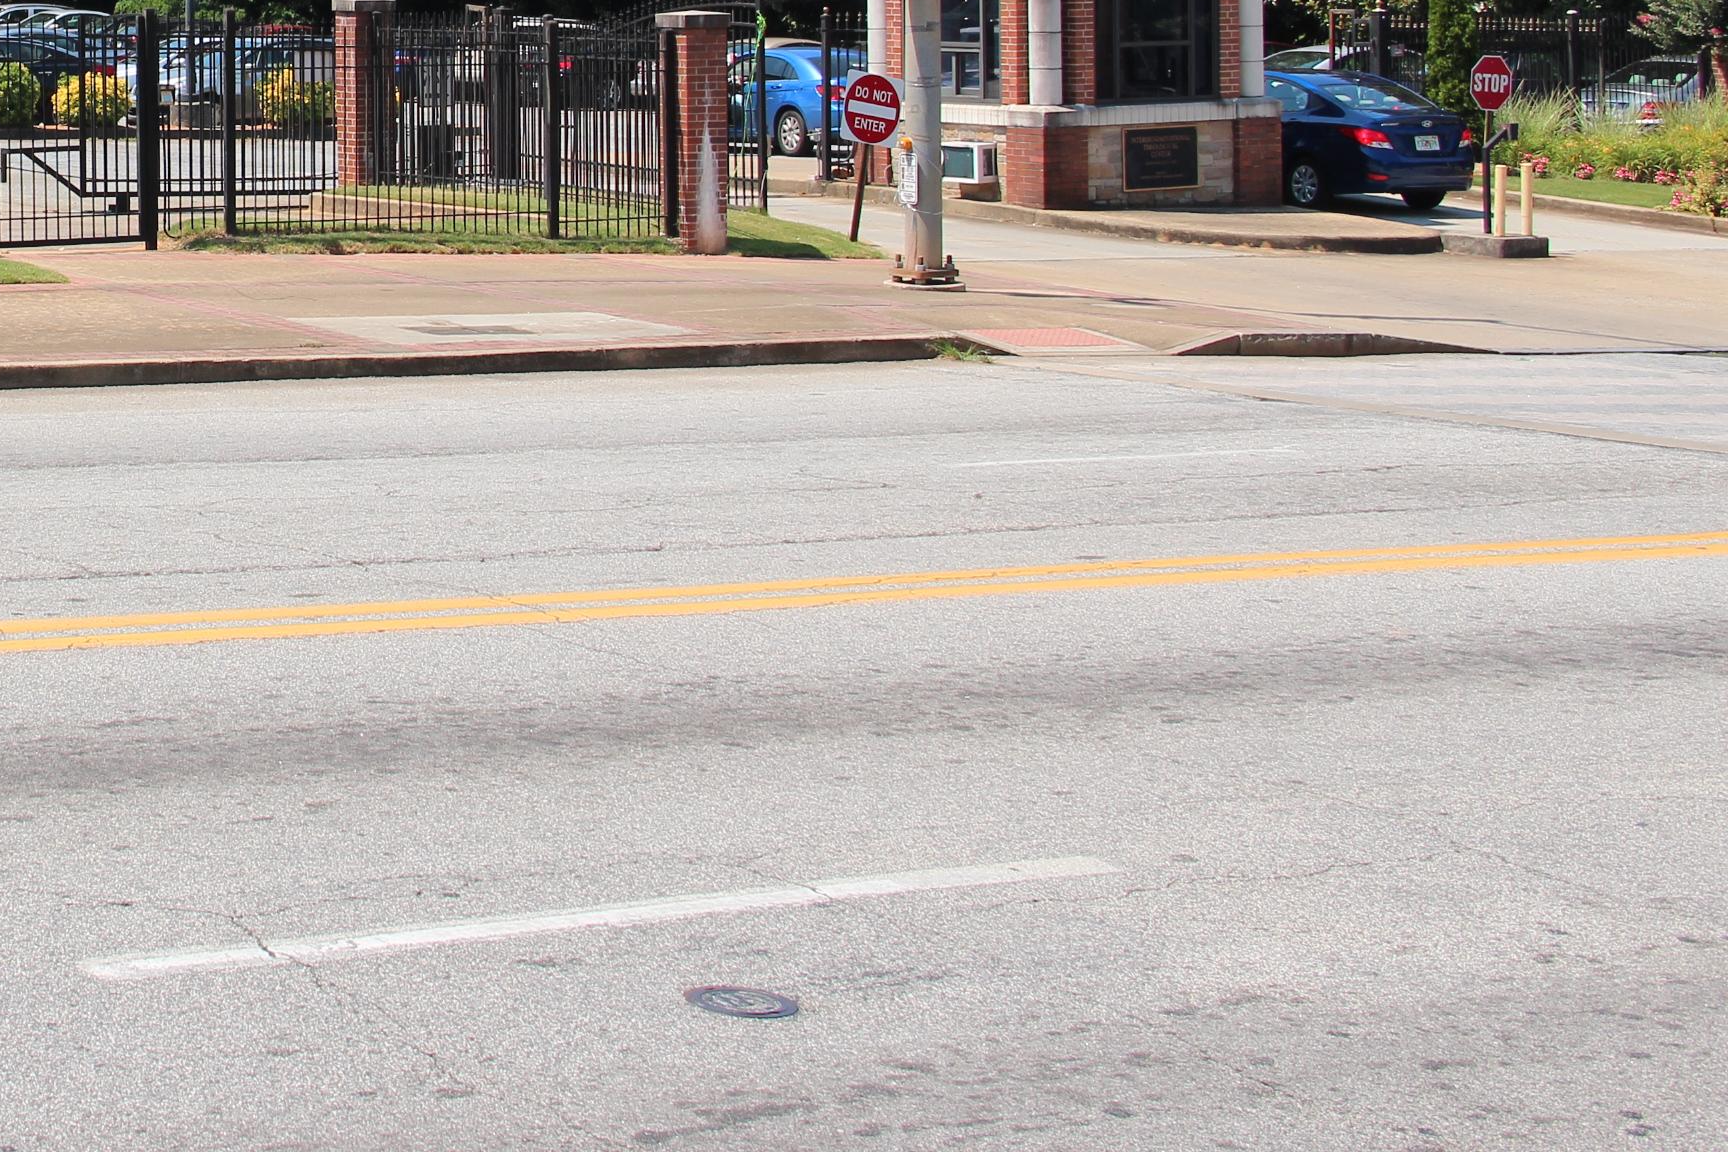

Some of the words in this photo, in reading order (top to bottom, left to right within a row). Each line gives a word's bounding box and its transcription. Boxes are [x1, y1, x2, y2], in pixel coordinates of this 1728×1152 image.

[1473, 72, 1509, 93] STOP
[855, 85, 869, 99] DO
[872, 89, 893, 104] NOT
[854, 117, 886, 134] ENTER
